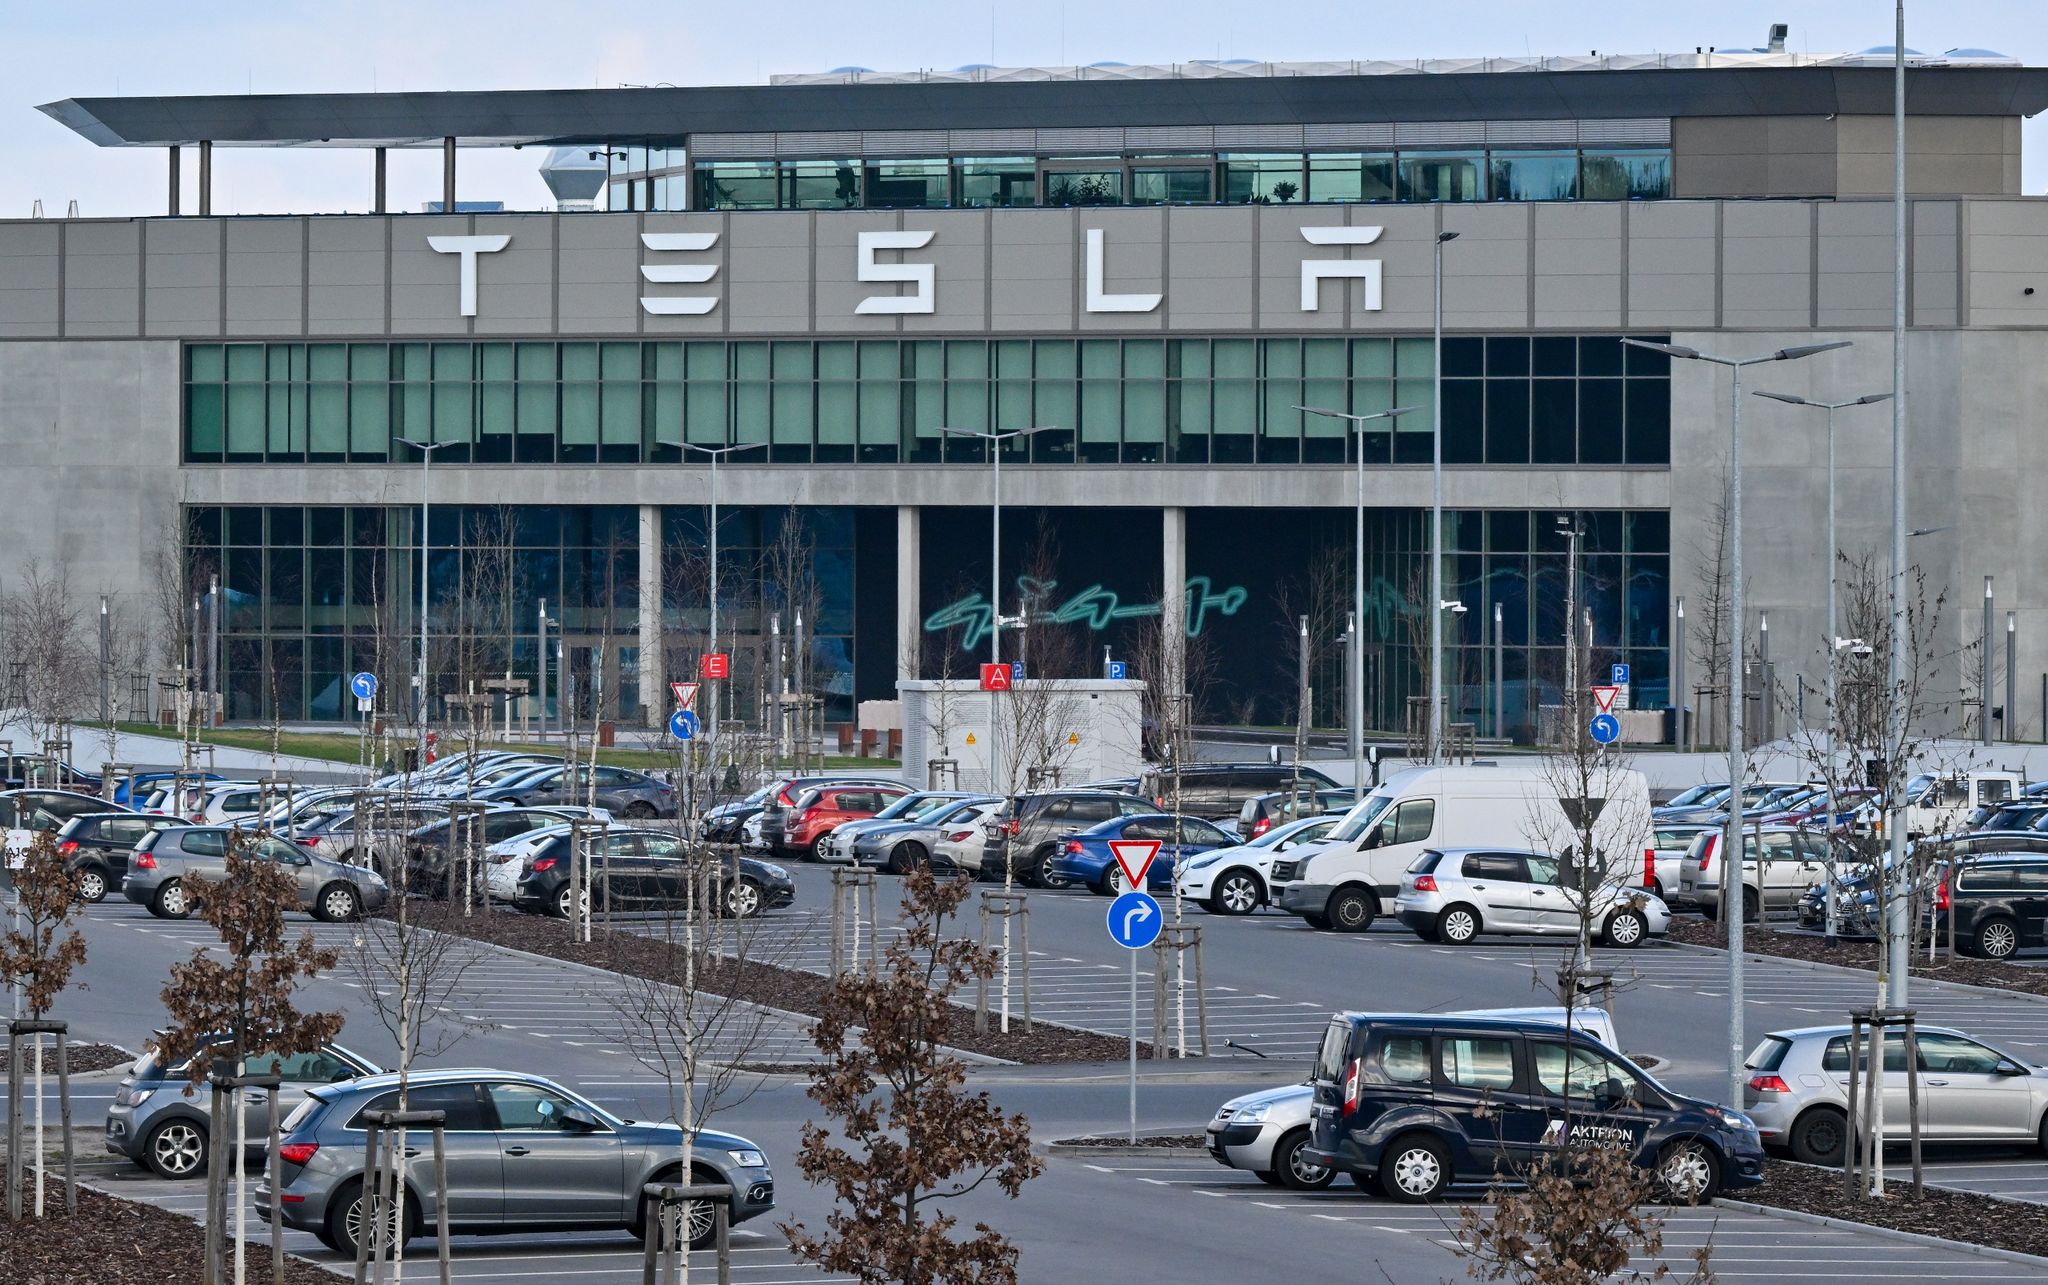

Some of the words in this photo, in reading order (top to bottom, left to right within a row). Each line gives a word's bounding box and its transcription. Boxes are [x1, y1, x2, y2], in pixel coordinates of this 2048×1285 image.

[427, 226, 1382, 316] TESLA
[710, 657, 721, 673] E
[1112, 664, 1121, 678] P
[990, 667, 1006, 685] A
[1614, 666, 1624, 681] P
[1569, 1125, 1633, 1141] AKTRION
[1568, 1138, 1632, 1151] AUTOMOIVE
